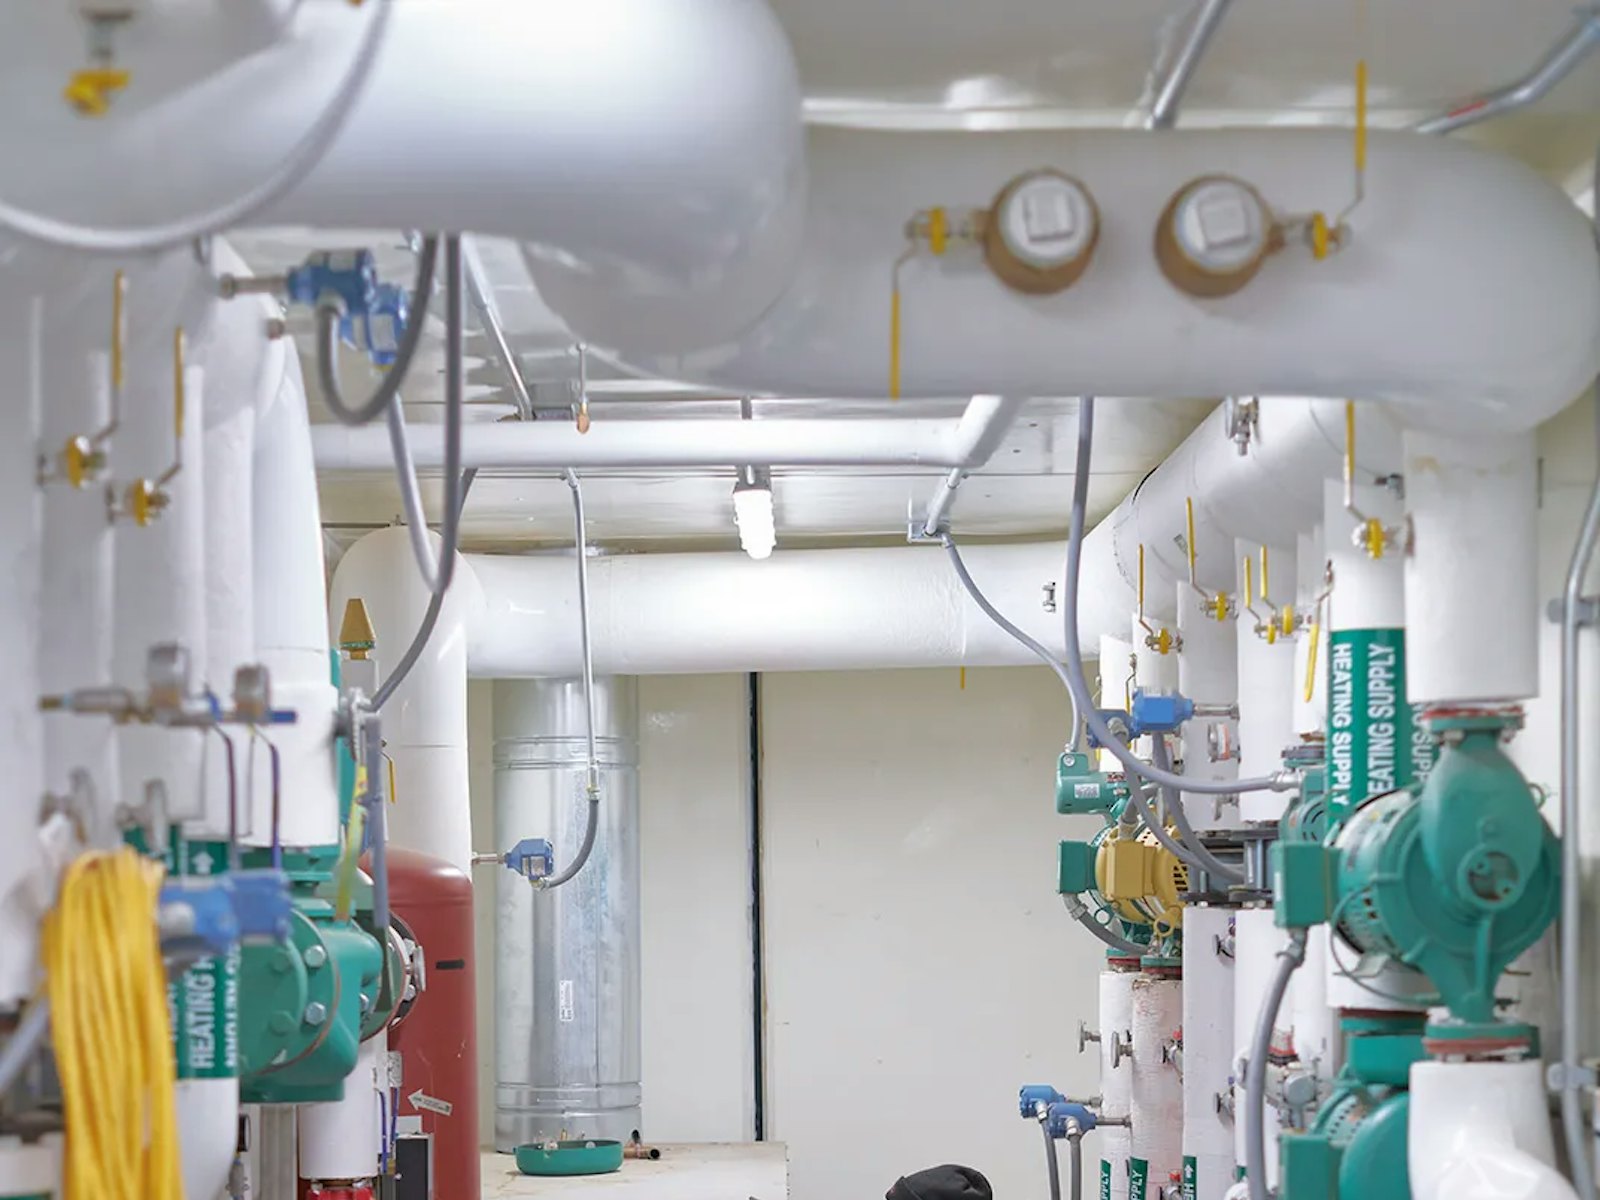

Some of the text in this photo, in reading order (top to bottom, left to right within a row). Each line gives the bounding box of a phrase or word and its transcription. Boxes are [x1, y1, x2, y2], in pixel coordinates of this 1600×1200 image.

[1331, 643, 1353, 806] HEATING SUPPLY
[1367, 643, 1396, 796] EATING SUPPLY
[184, 970, 216, 1069] HEATING
